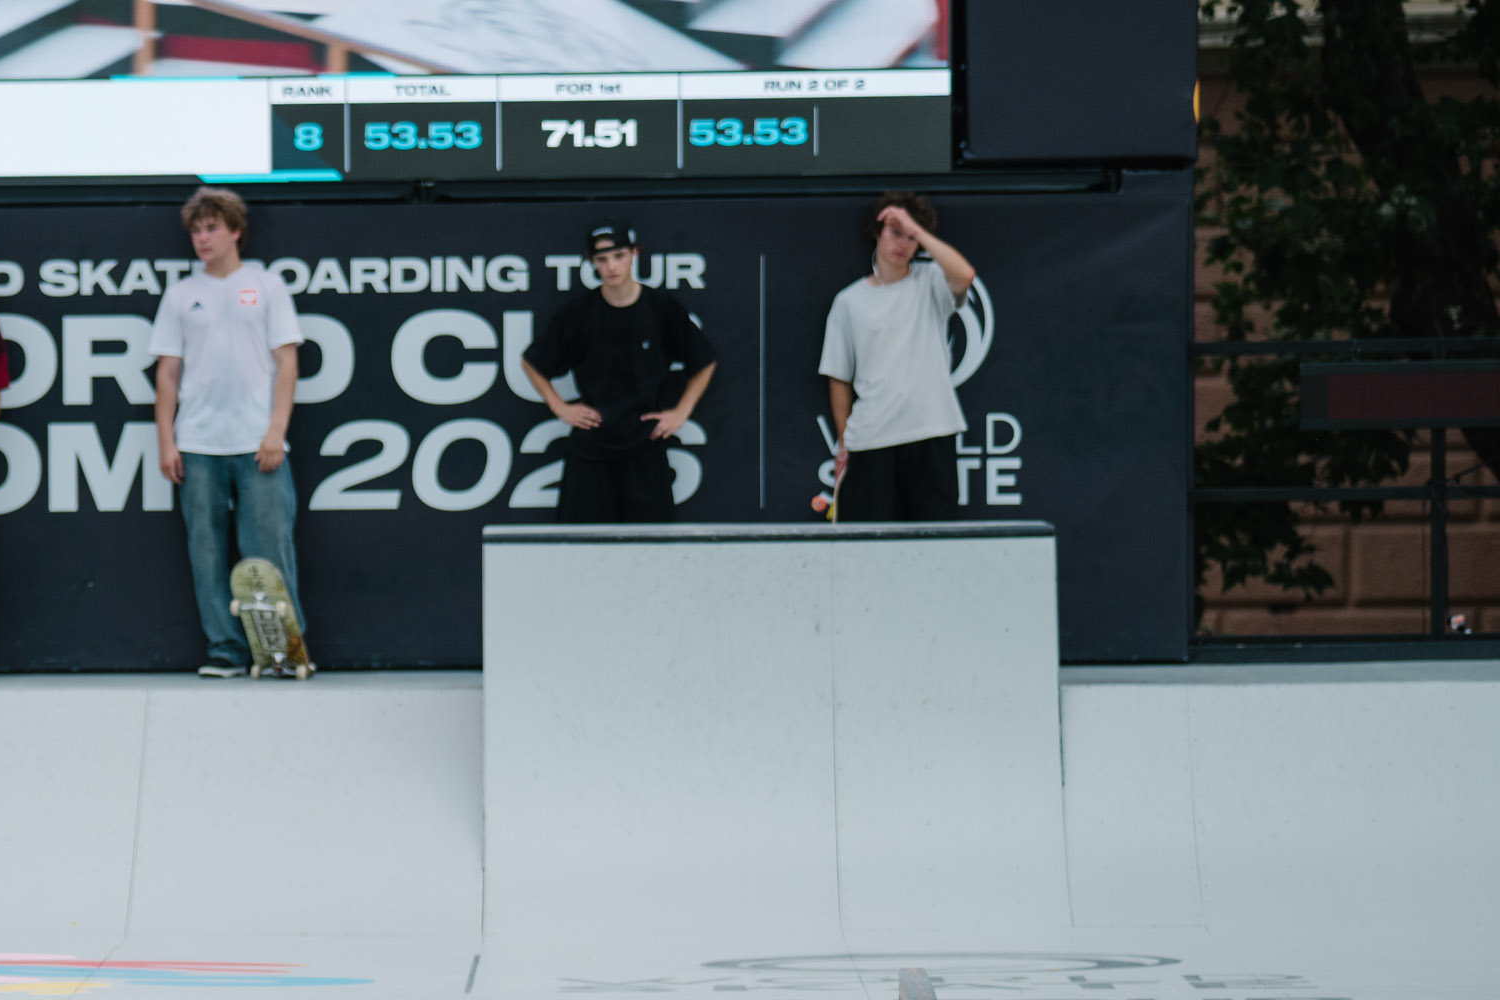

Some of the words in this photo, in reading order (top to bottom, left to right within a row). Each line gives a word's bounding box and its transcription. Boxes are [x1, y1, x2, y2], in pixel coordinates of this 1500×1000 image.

[282, 86, 332, 98] RANK
[395, 84, 451, 97] TOTAL
[555, 83, 593, 95] FOR
[763, 79, 801, 92] RUN
[809, 78, 819, 91] 2
[824, 79, 849, 91] OF
[854, 78, 865, 91] 2
[293, 122, 324, 151] 8
[364, 120, 483, 150] 53.53
[541, 119, 638, 148] 71.51
[688, 116, 809, 147] 53.53
[39, 256, 530, 296] SKATOARDING
